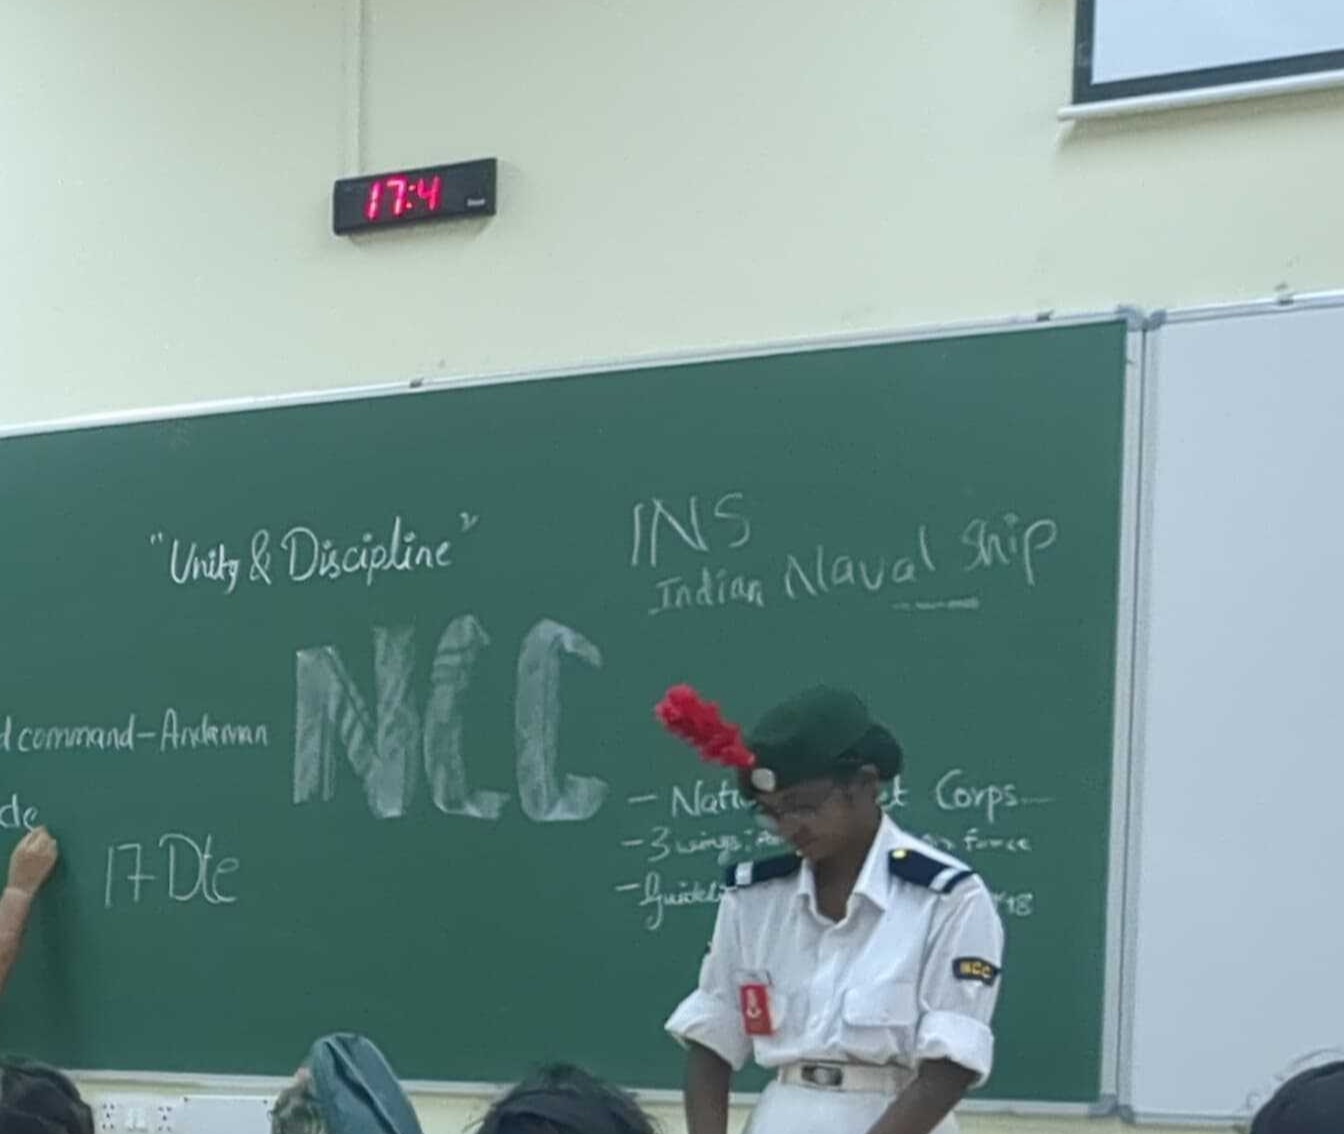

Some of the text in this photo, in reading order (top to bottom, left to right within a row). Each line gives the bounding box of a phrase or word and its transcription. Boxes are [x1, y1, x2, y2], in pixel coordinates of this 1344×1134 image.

[248, 528, 273, 585] &
[631, 491, 751, 567] INS
[648, 566, 766, 616] Indian
[784, 524, 936, 600] Naval
[291, 613, 609, 822] NCC
[105, 833, 240, 908] 17 Dte
